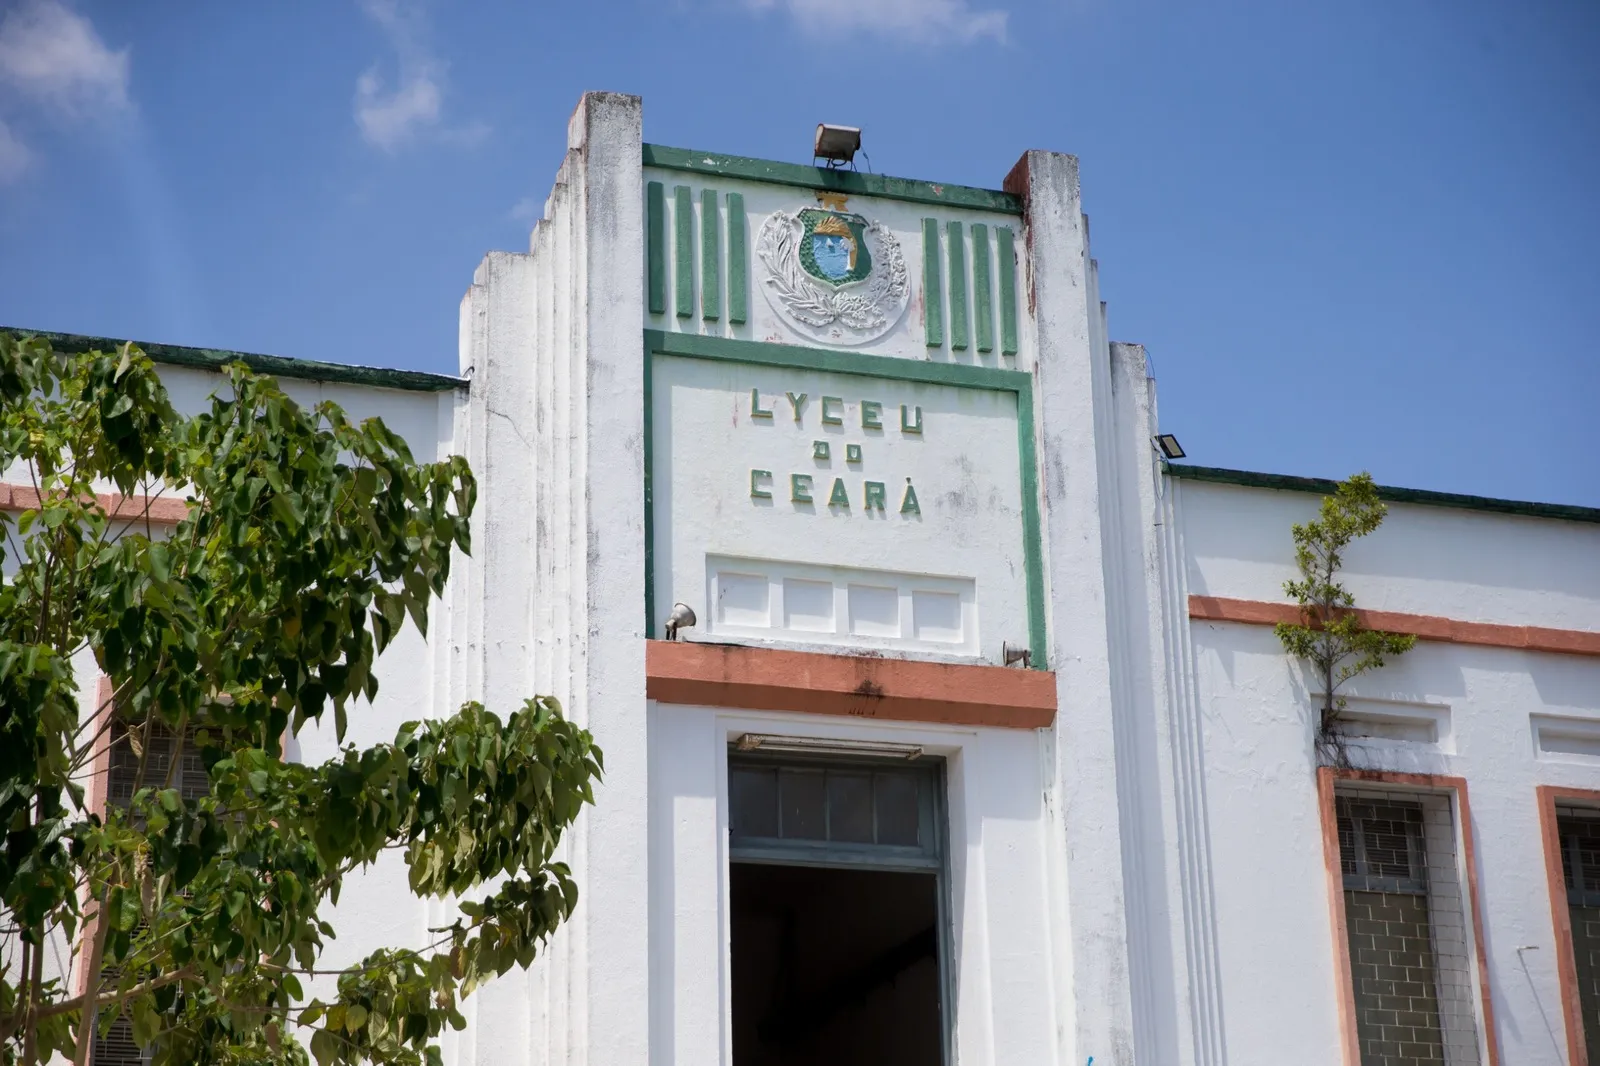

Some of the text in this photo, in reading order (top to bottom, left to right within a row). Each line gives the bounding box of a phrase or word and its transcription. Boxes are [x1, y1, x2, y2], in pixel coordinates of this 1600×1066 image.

[751, 388, 922, 434] LYCEU
[813, 440, 861, 463] DO
[750, 469, 921, 515] CEARÁ
